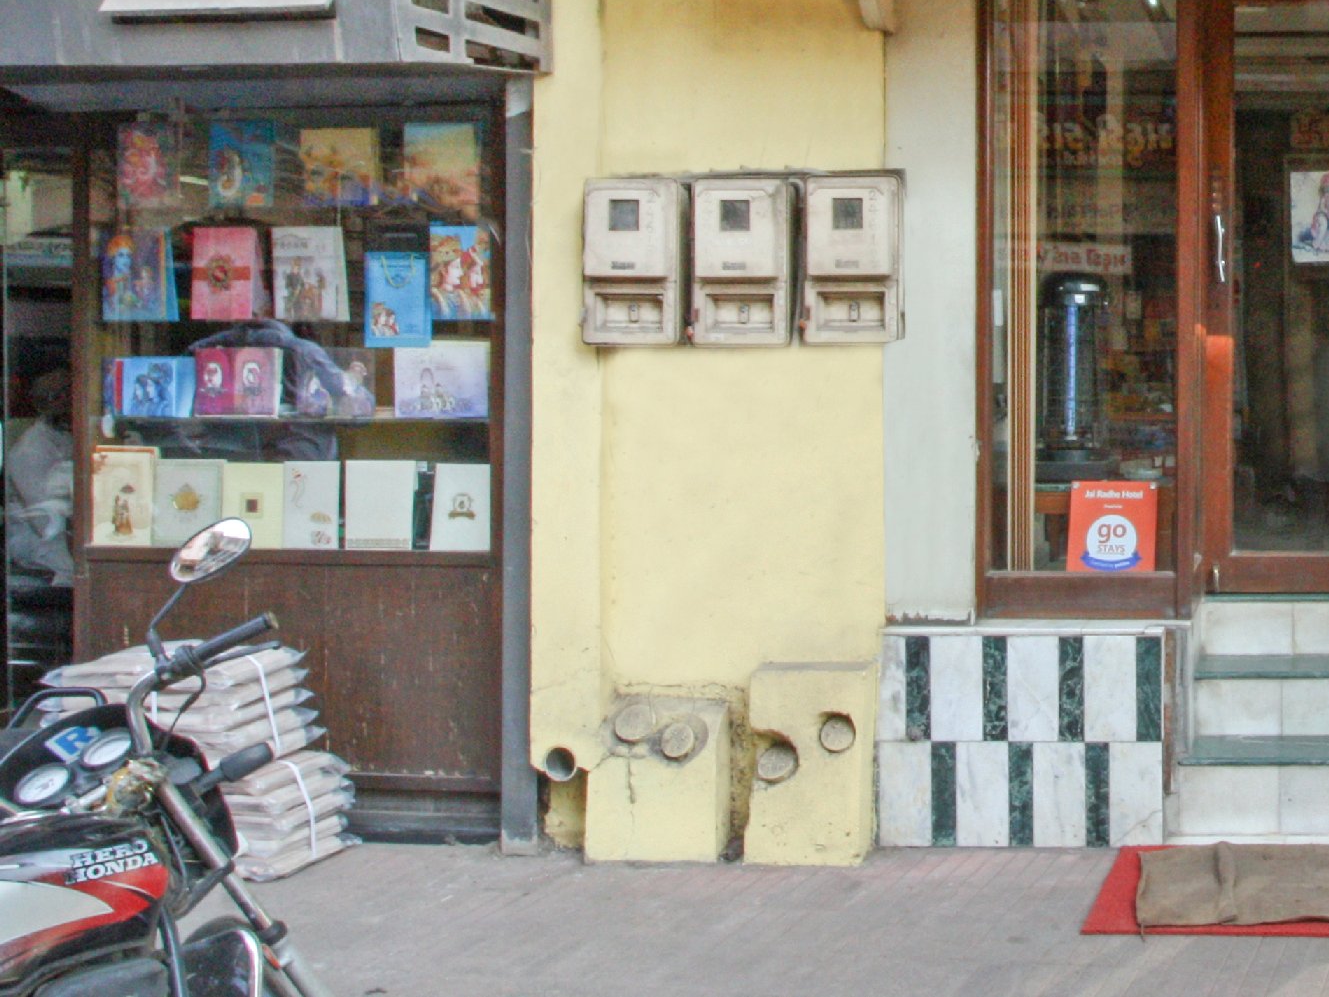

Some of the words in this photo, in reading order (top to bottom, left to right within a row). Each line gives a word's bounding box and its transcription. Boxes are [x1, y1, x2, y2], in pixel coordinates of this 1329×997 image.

[1122, 490, 1144, 500] Hotel
[1097, 523, 1128, 544] go
[1097, 545, 1126, 554] STAYS
[70, 838, 148, 868] HERO
